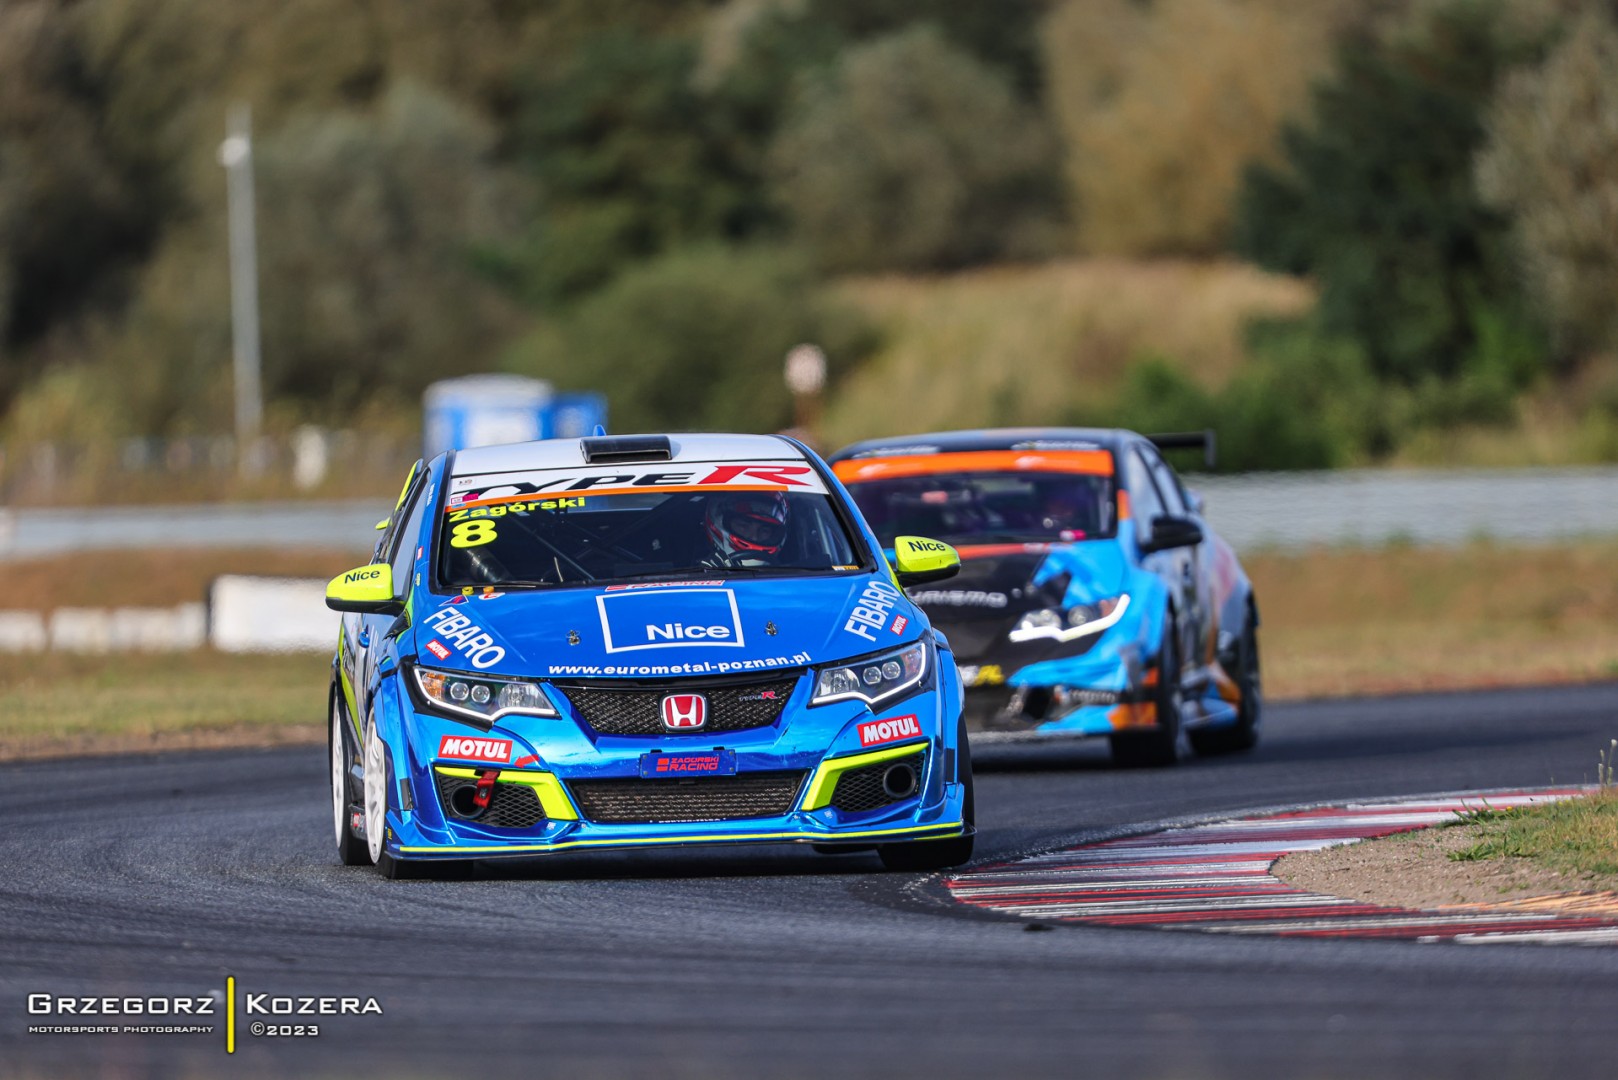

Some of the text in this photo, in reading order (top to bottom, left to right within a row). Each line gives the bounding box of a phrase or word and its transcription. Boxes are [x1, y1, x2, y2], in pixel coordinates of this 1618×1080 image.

[697, 465, 813, 487] R
[449, 497, 586, 522] Zagórski
[450, 518, 498, 548] 8
[907, 540, 946, 552] Nice
[344, 569, 381, 584] Nice
[844, 580, 901, 642] FIBARO
[423, 606, 506, 669] FIBARO
[646, 622, 731, 641] Nice
[548, 651, 812, 675] www.eurometal-poznan.pl
[863, 717, 920, 743] MOTUL
[441, 738, 508, 759] MOTUL
[669, 762, 719, 771] RACING
